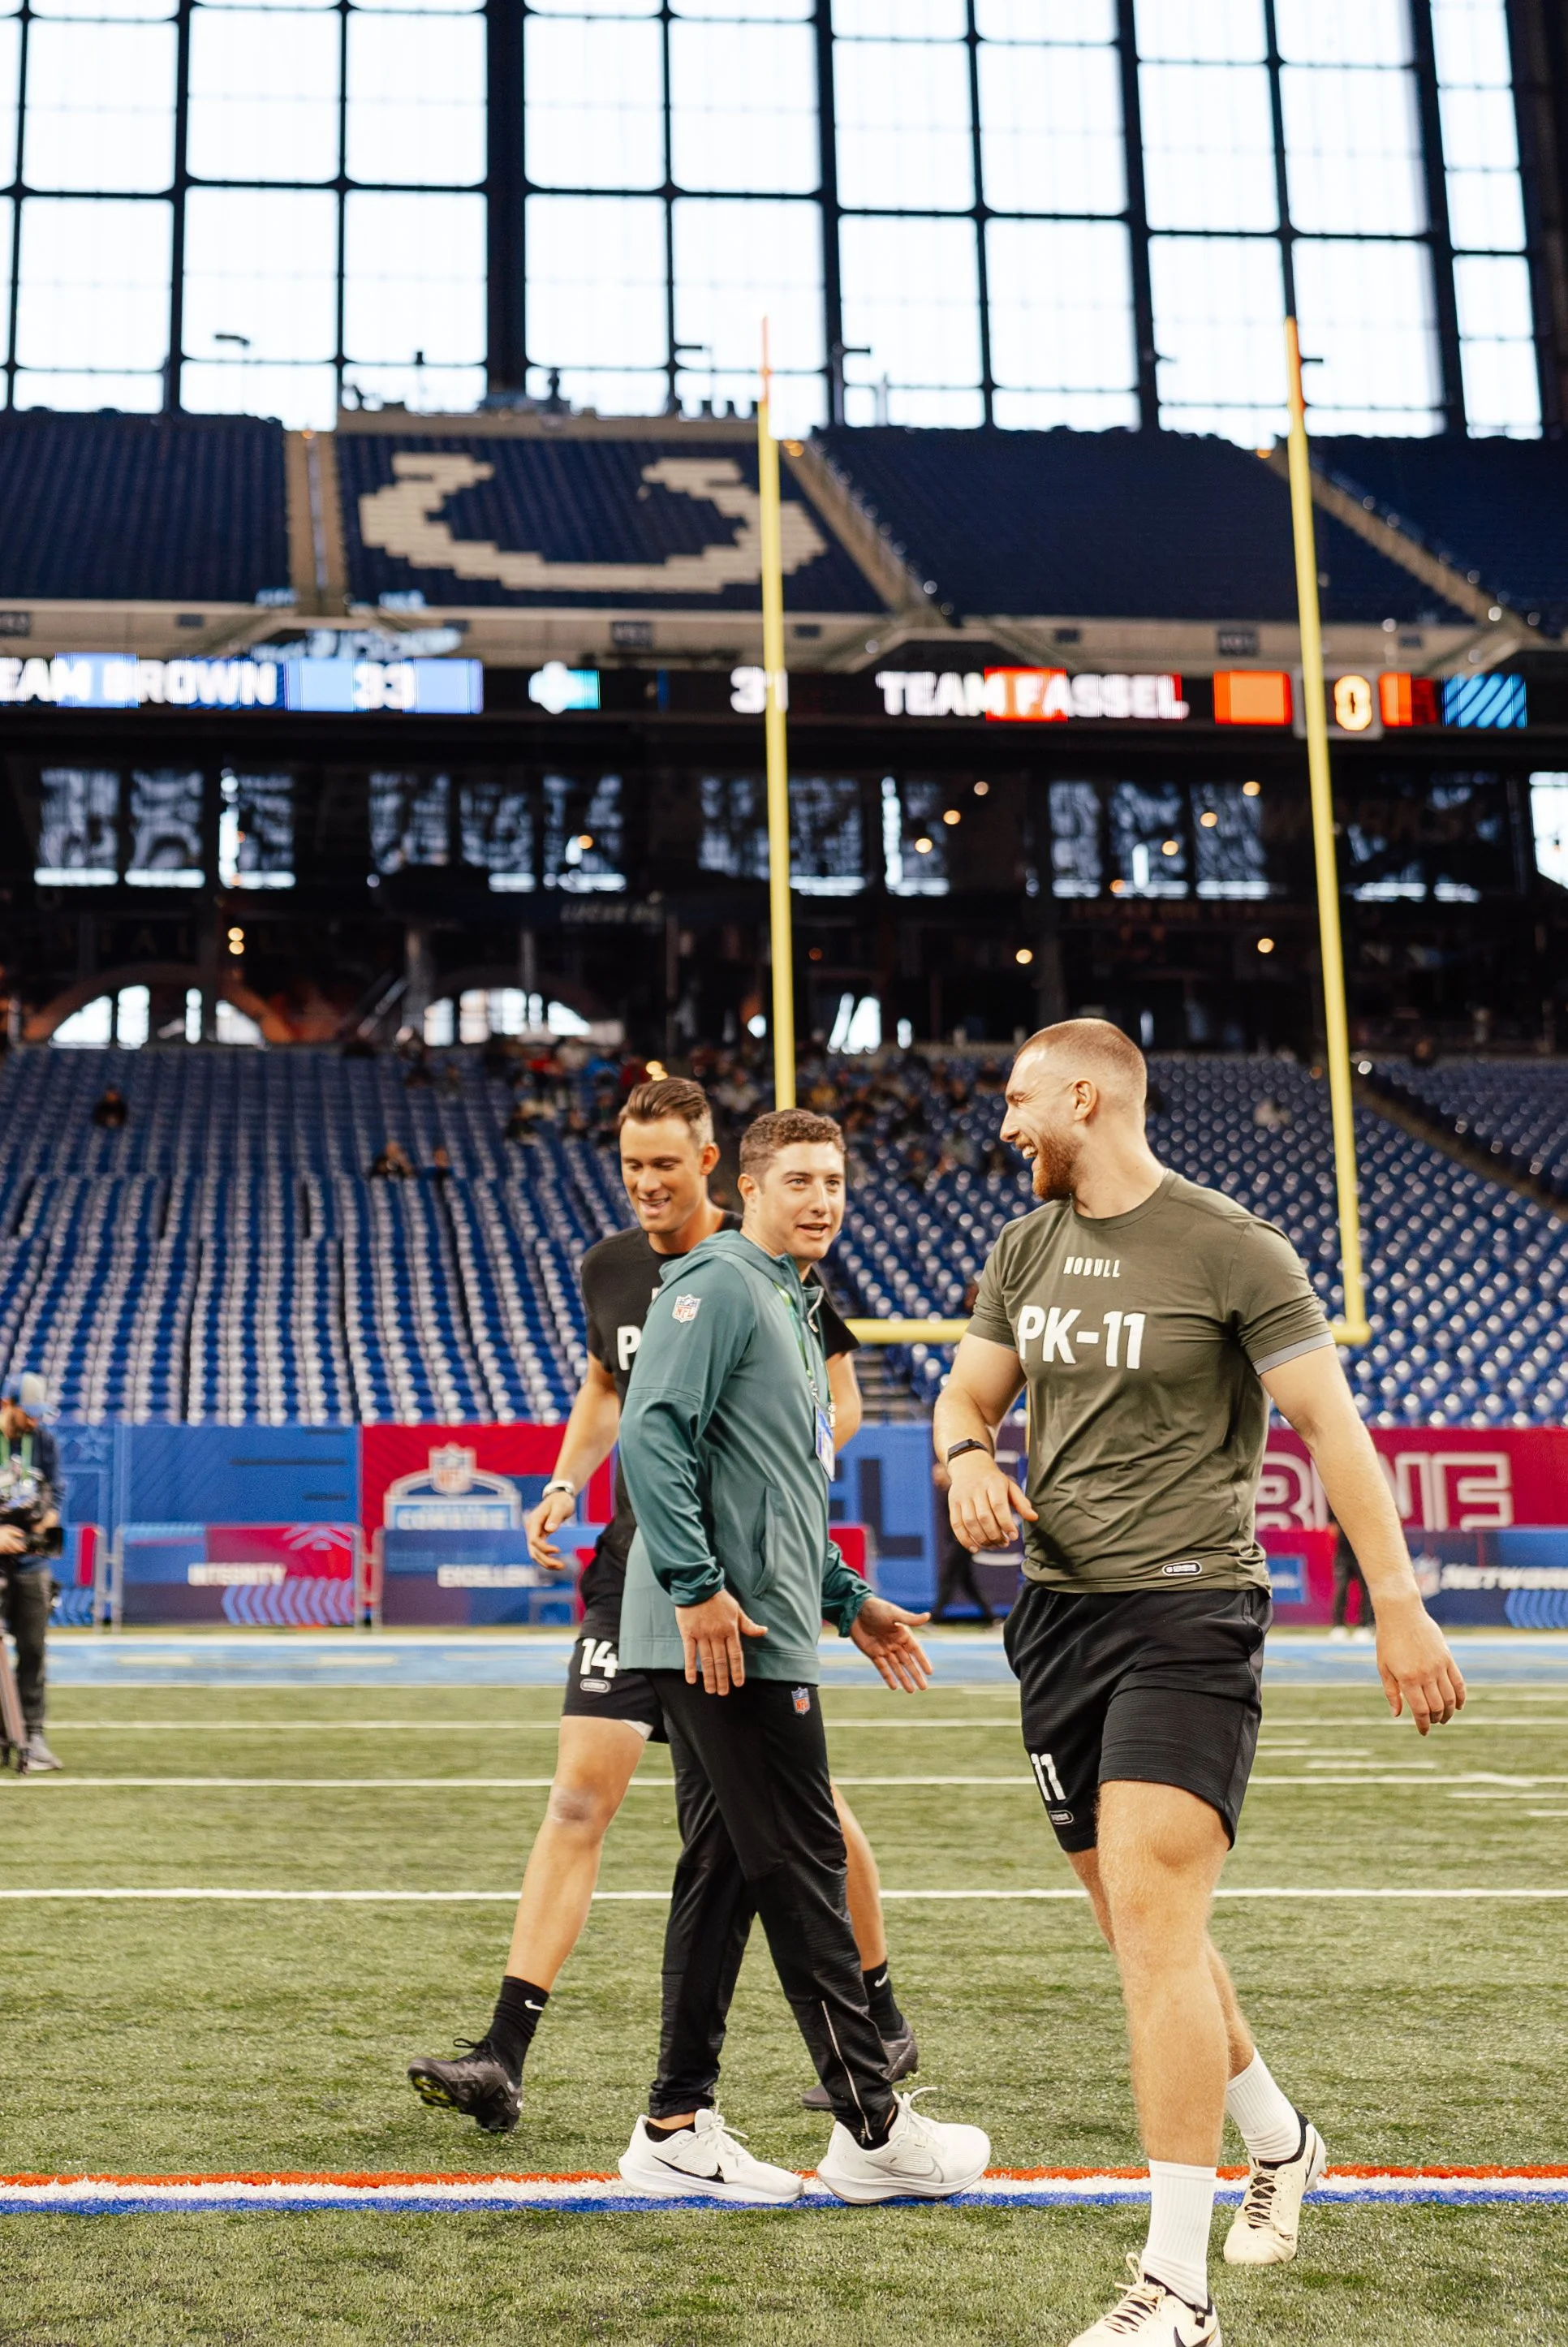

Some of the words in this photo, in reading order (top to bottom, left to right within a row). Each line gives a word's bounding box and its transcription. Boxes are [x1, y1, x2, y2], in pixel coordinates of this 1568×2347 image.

[102, 659, 278, 705] BROWN
[875, 671, 1006, 716] TEAM
[1014, 673, 1190, 719] FASSEL
[1334, 674, 1372, 730] 0
[1062, 1256, 1121, 1278] NOBULL
[1017, 1304, 1146, 1369] PK-11
[579, 1638, 619, 1678] 14
[1030, 1753, 1066, 1801] 11
